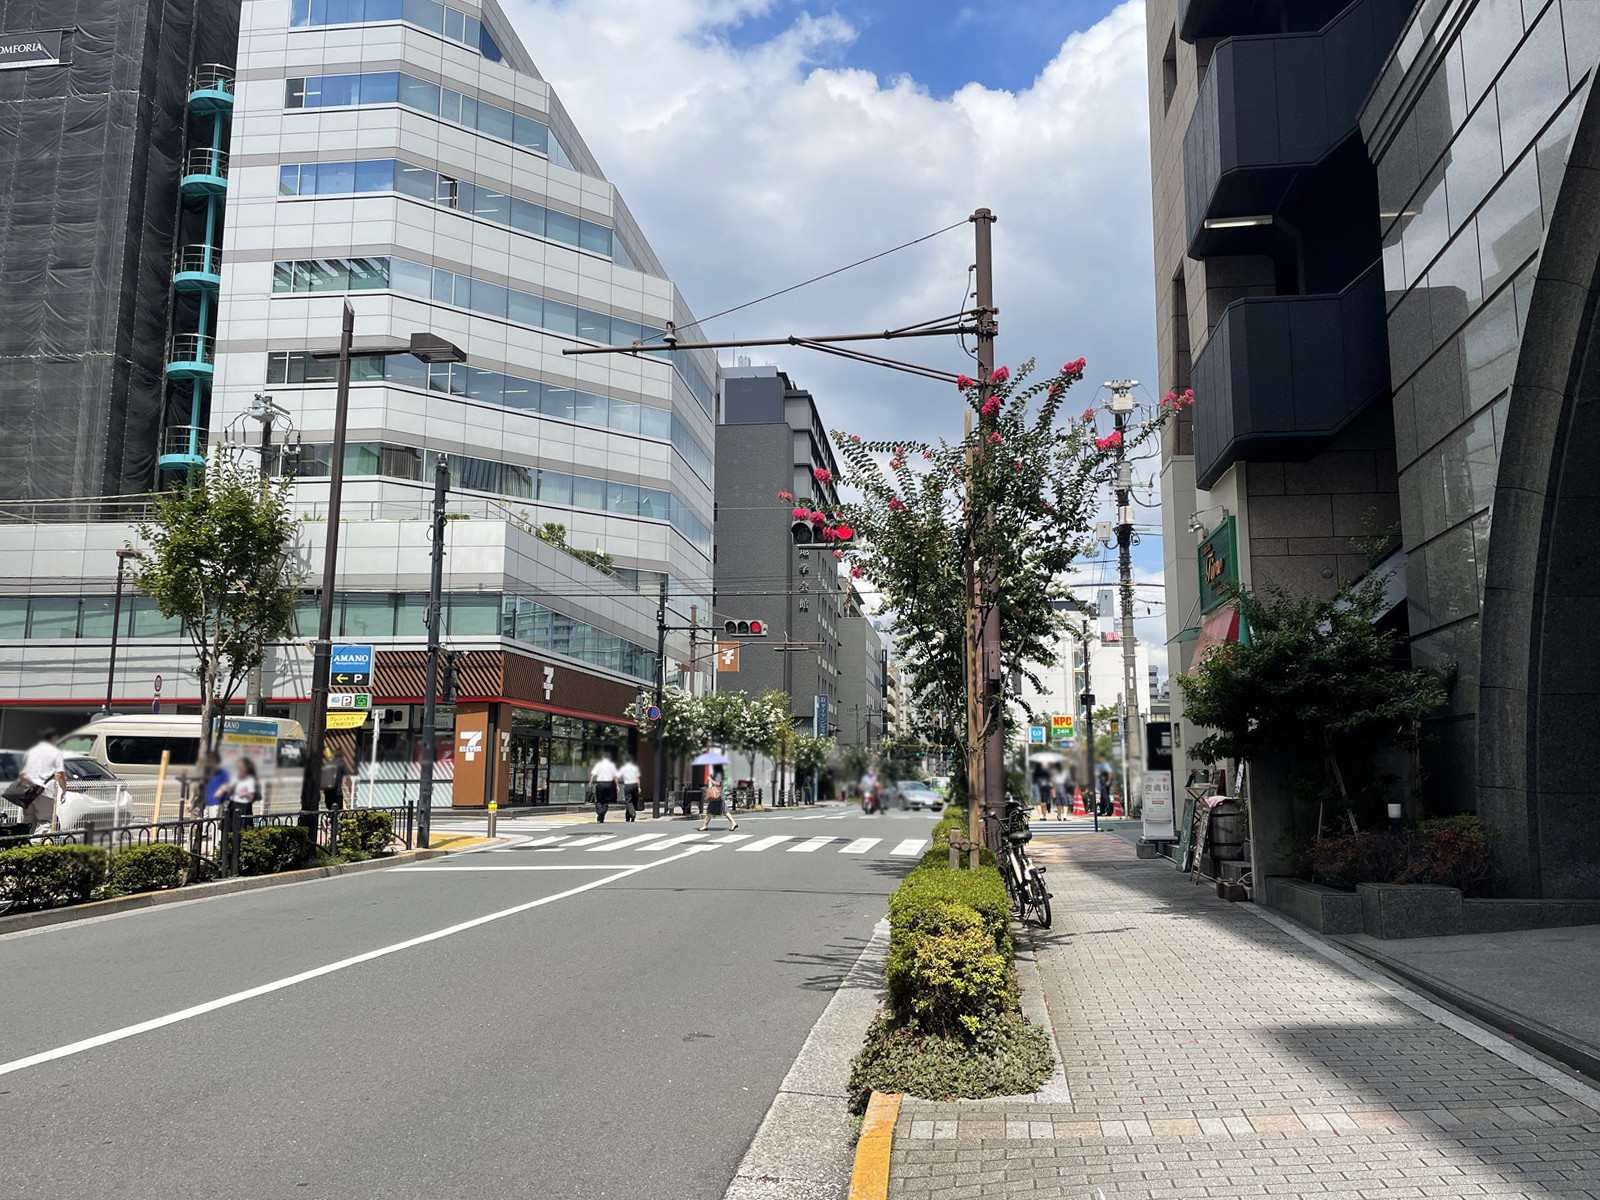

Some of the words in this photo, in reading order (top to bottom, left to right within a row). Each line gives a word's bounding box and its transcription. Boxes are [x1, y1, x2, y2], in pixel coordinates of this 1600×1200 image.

[333, 654, 369, 662] AMANO
[353, 673, 363, 684] P
[1053, 716, 1072, 726] NPC
